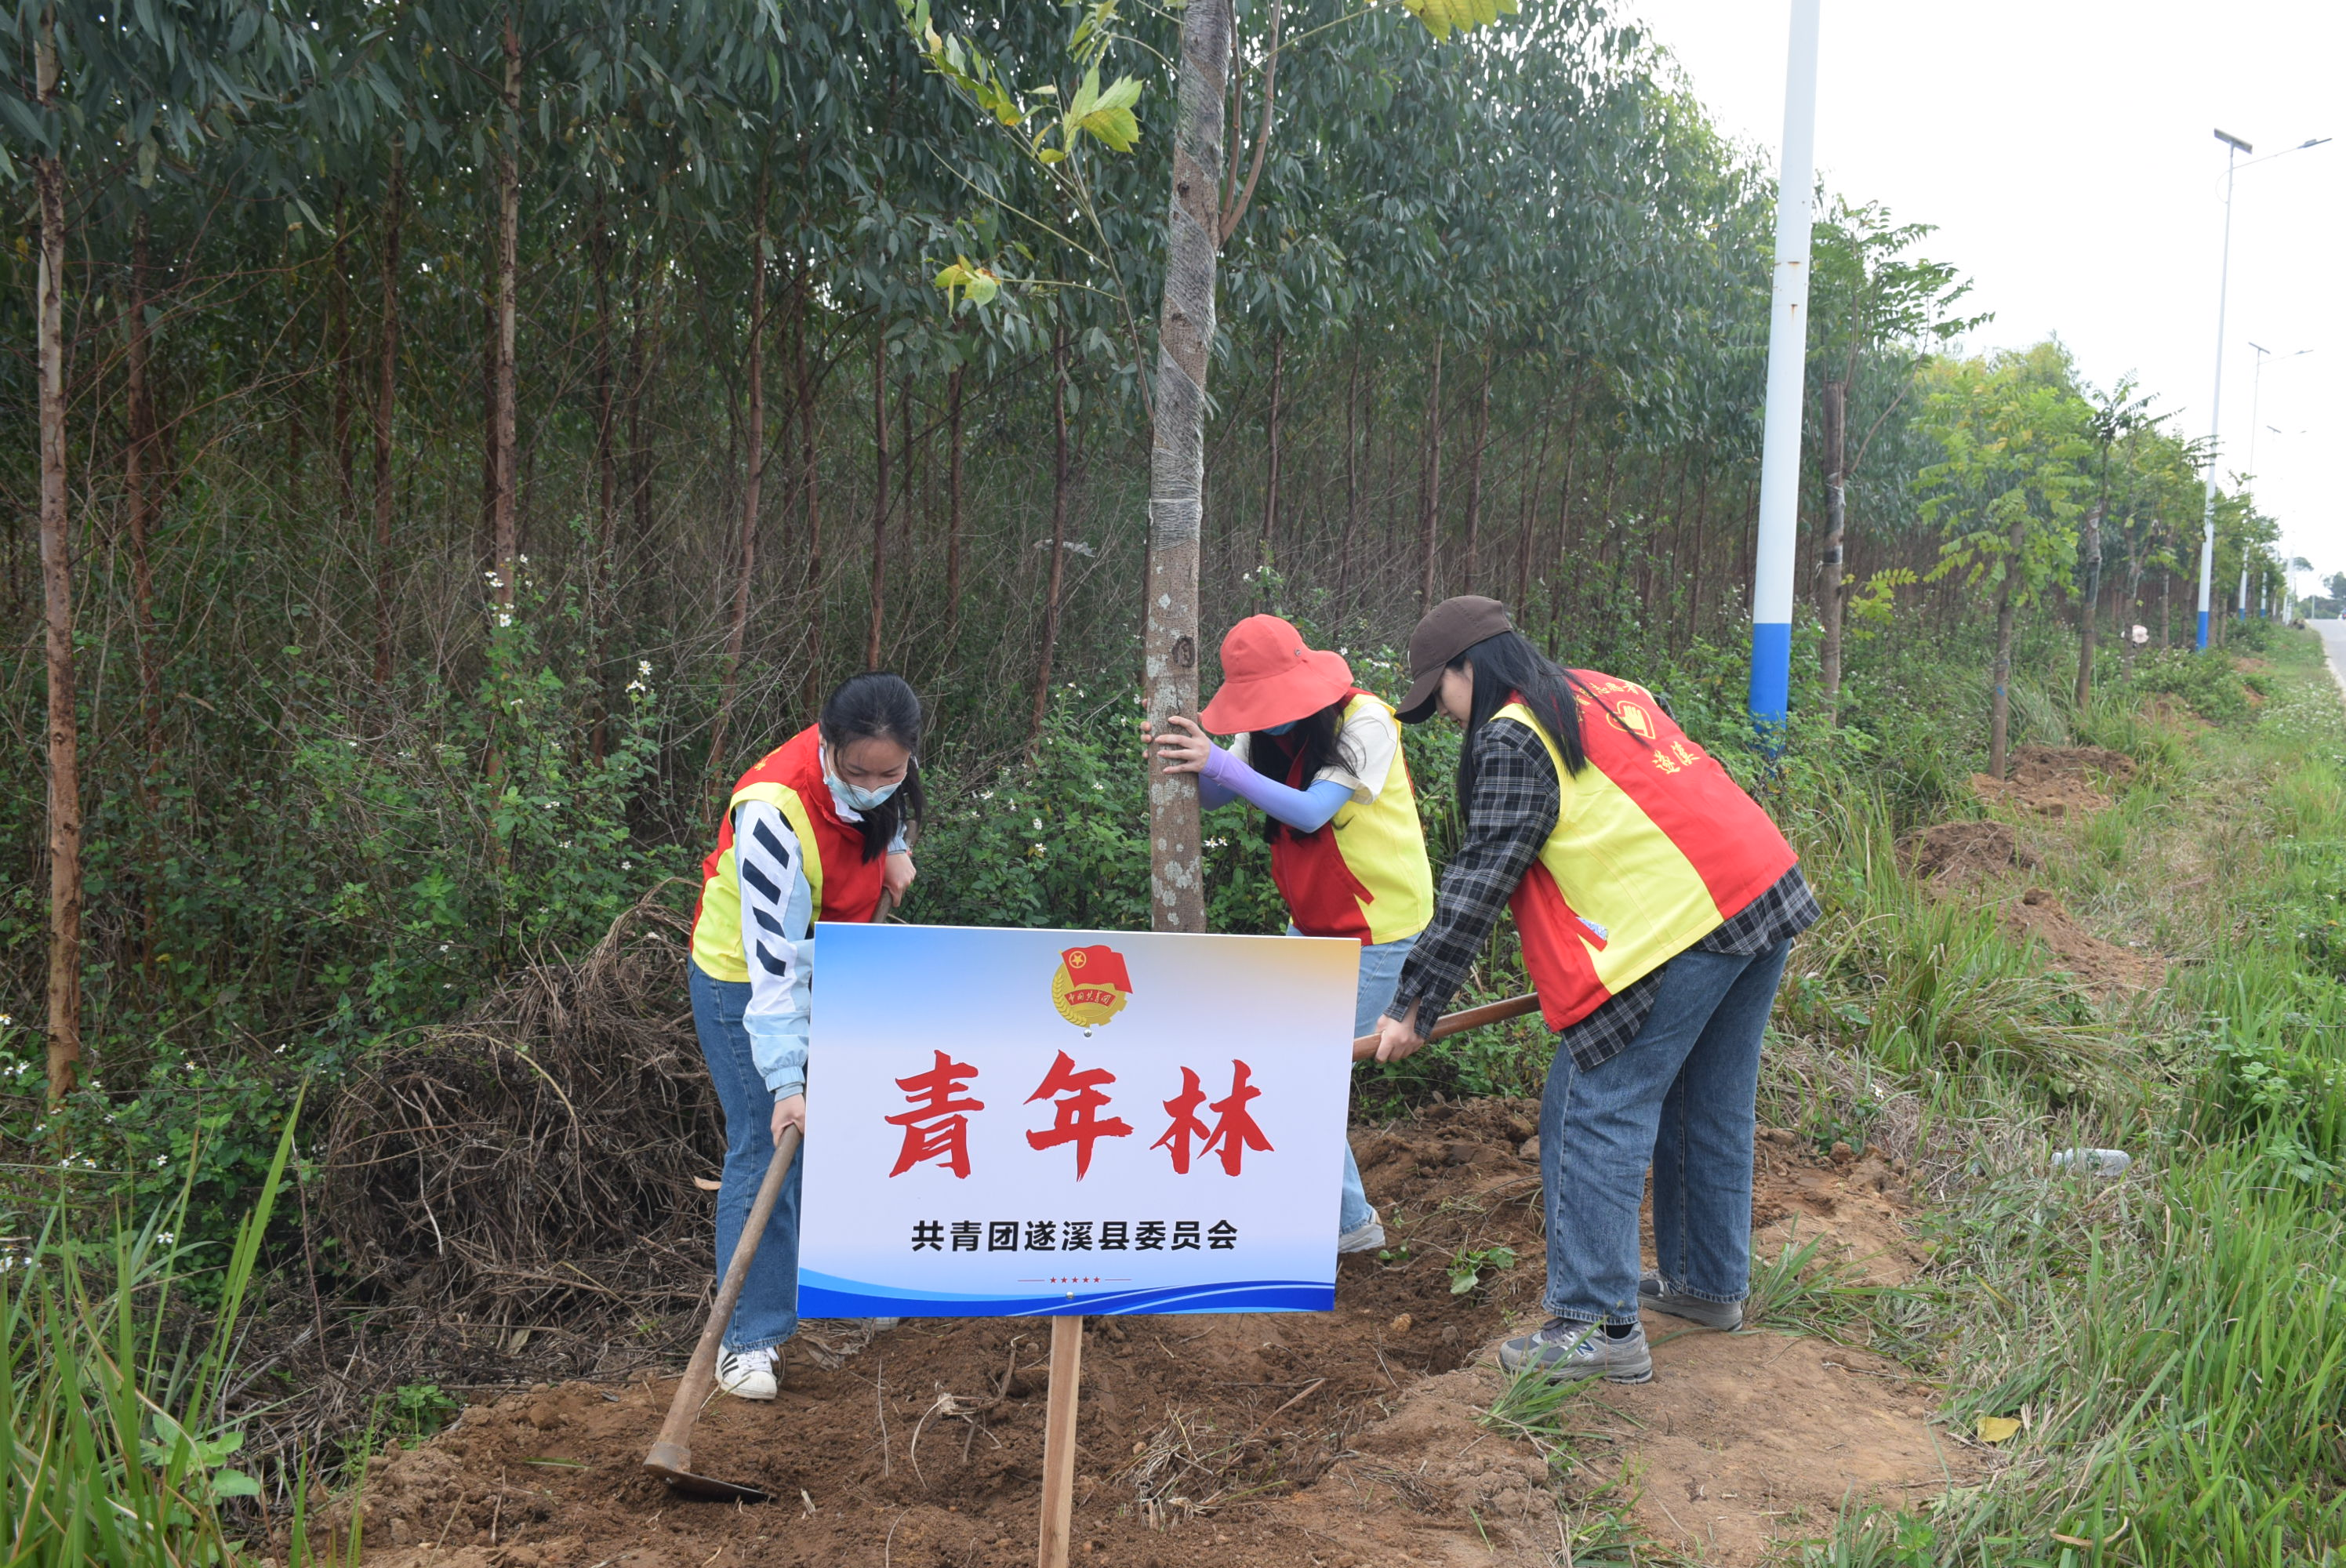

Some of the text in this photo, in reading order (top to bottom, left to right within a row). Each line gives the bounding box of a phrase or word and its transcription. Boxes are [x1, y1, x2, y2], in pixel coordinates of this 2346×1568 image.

[884, 1049, 1274, 1181] 青年林
[911, 1219, 1238, 1252] 共青团遂溪县委员会
